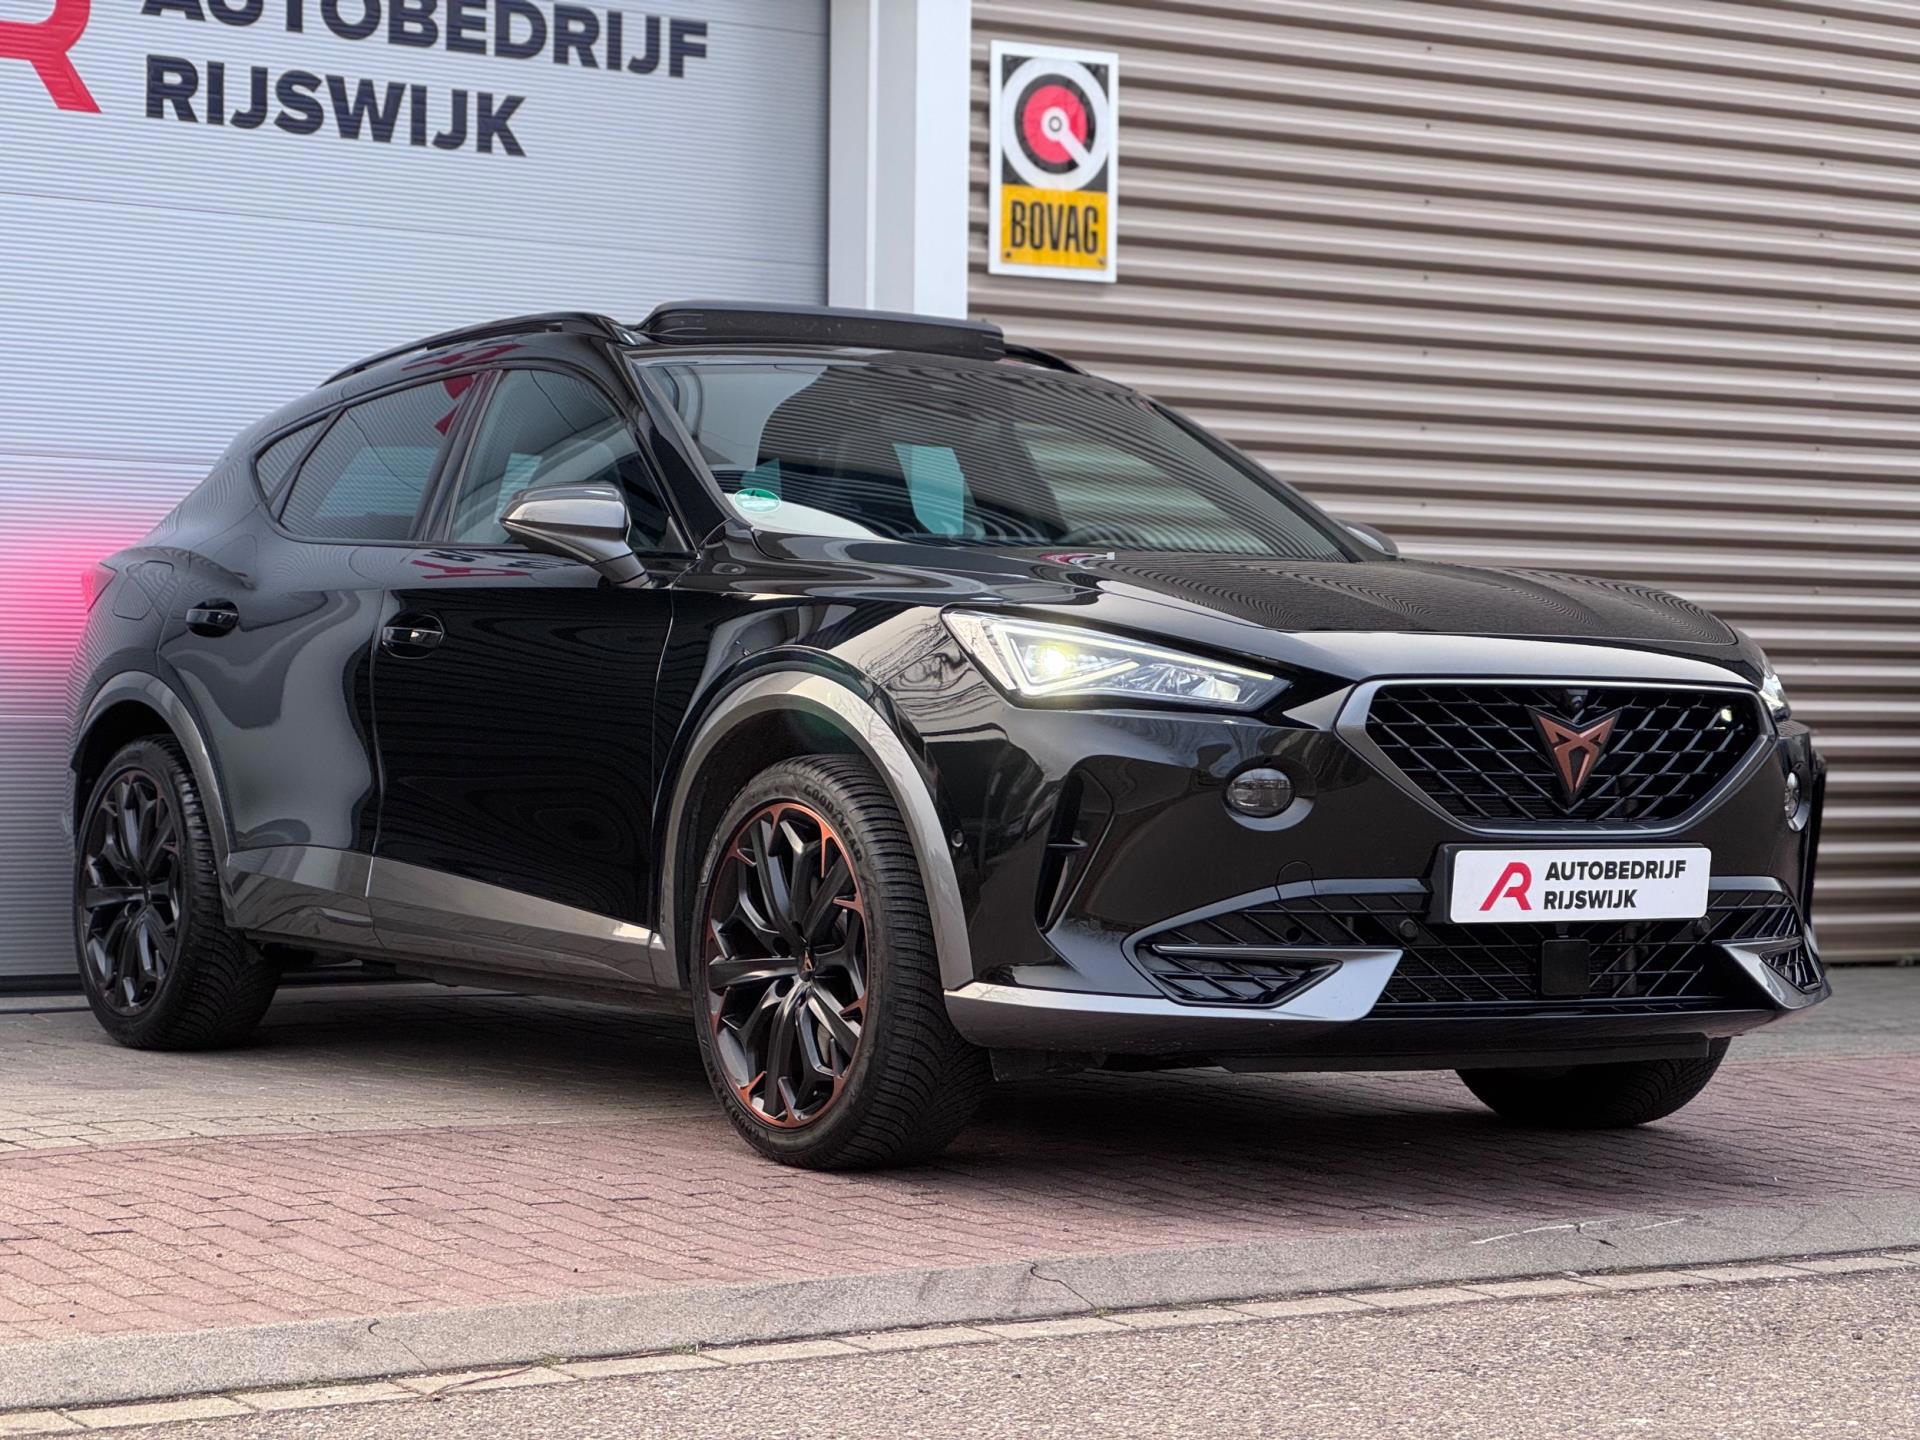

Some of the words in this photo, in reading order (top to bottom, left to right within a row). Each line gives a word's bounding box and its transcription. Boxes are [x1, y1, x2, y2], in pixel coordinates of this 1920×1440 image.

[145, 53, 526, 157] RIJSWIJK
[1009, 200, 1099, 254] BOVAG
[1545, 859, 1686, 881] AUTOBEDRIJF
[1543, 889, 1637, 910] RIJSWIJK
